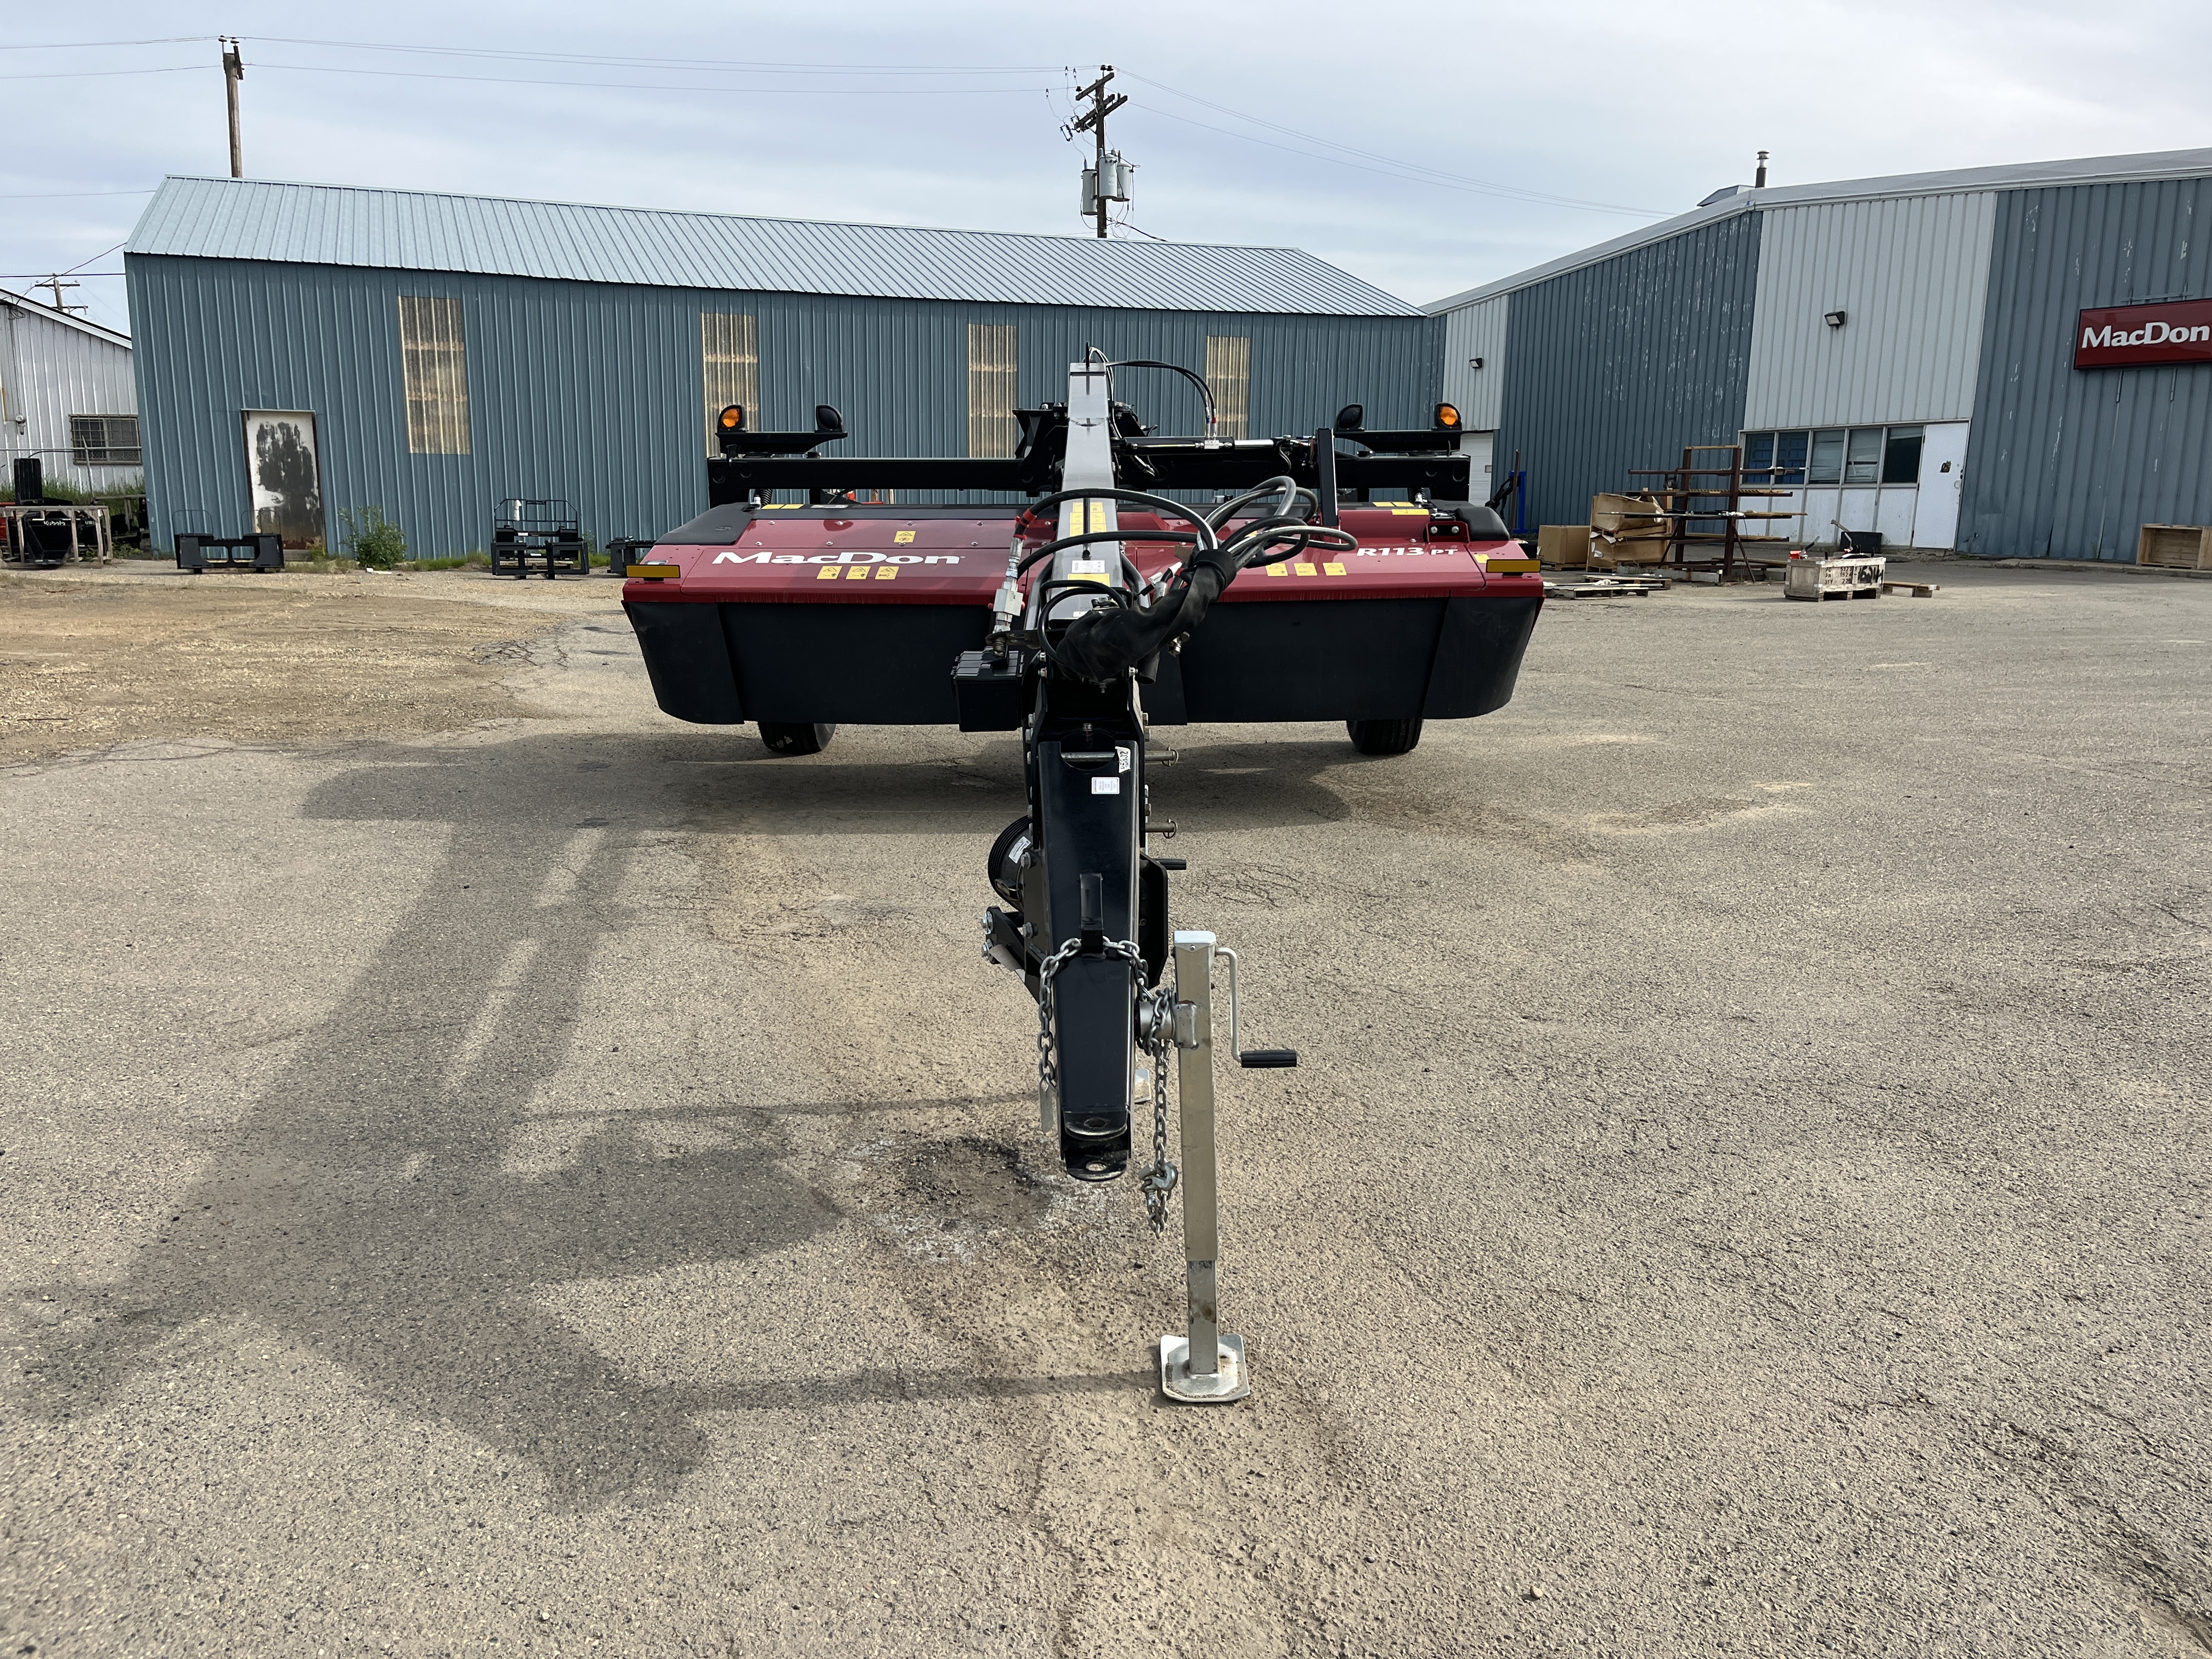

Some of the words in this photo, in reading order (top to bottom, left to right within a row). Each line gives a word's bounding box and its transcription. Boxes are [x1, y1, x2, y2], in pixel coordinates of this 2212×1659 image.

[2081, 321, 2210, 348] MacDon
[712, 551, 960, 565] MacDon
[1356, 547, 1425, 556] R113
